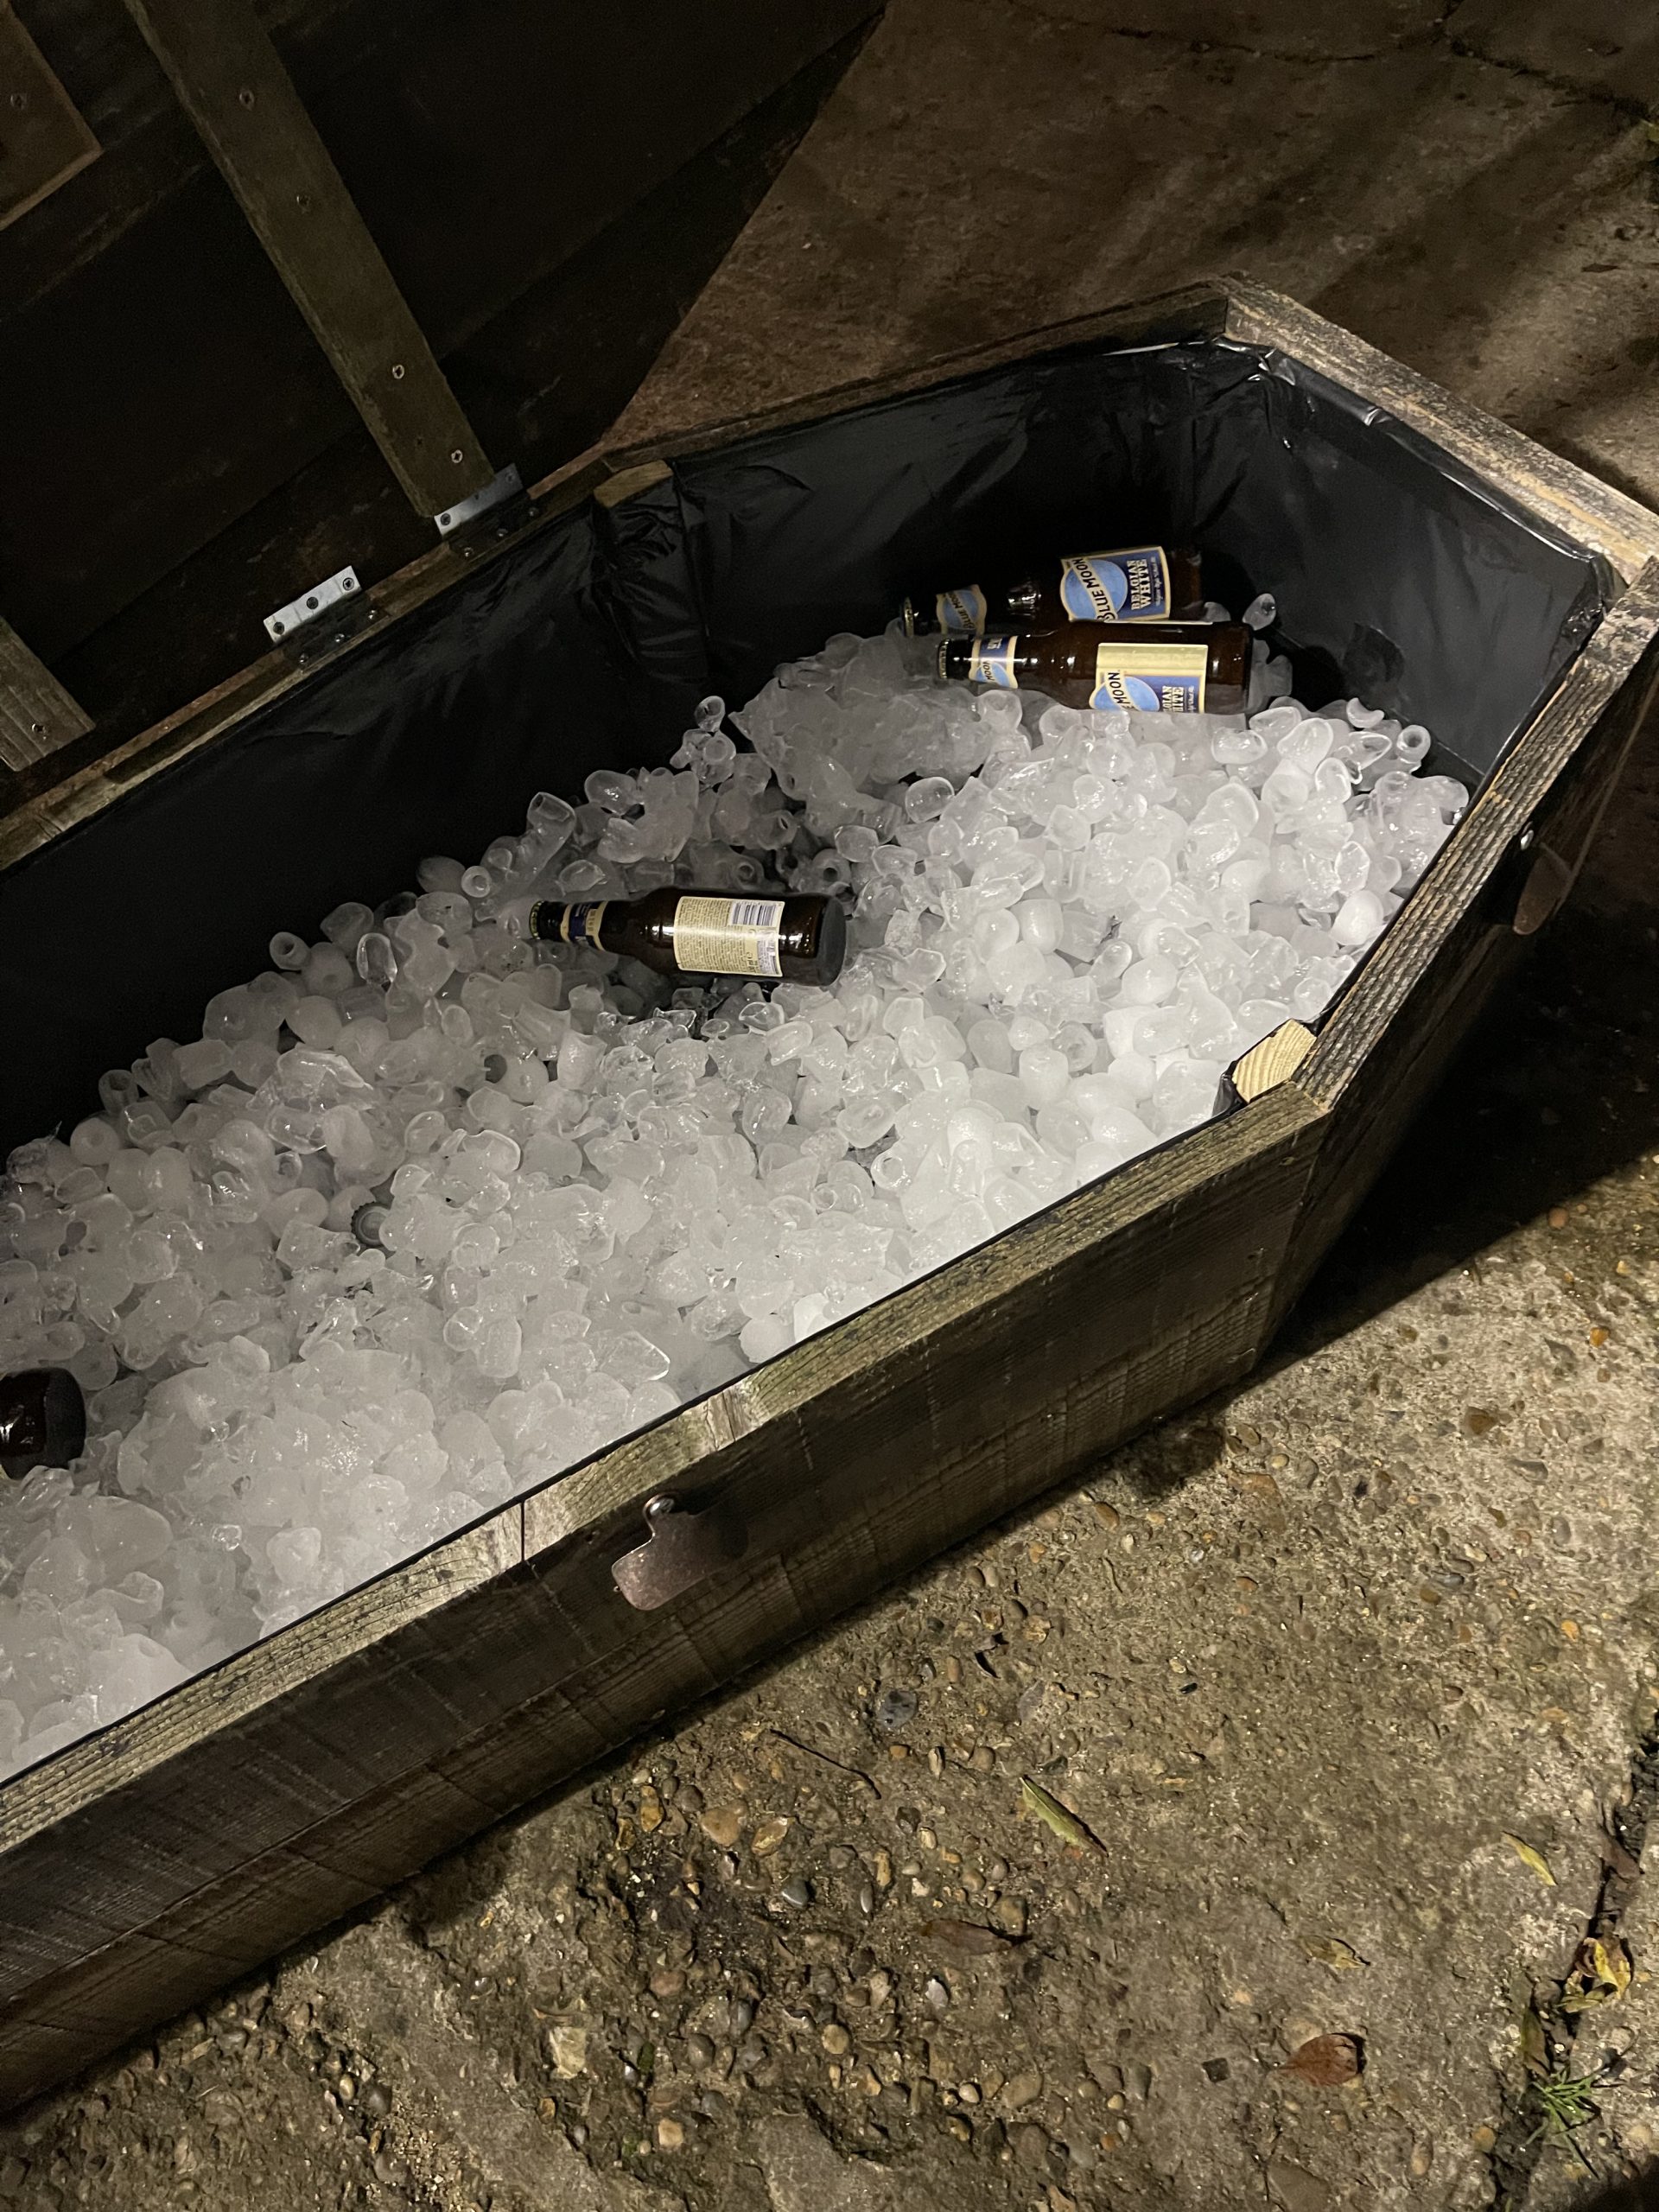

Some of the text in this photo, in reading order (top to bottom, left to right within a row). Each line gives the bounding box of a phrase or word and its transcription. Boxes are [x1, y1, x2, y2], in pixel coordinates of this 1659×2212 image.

[1072, 557, 1116, 622] BLUE MOON
[1127, 560, 1141, 611] BELGIAN
[1136, 558, 1152, 609] WHITE
[1108, 671, 1129, 704] MOON
[1172, 686, 1185, 713] HITE
